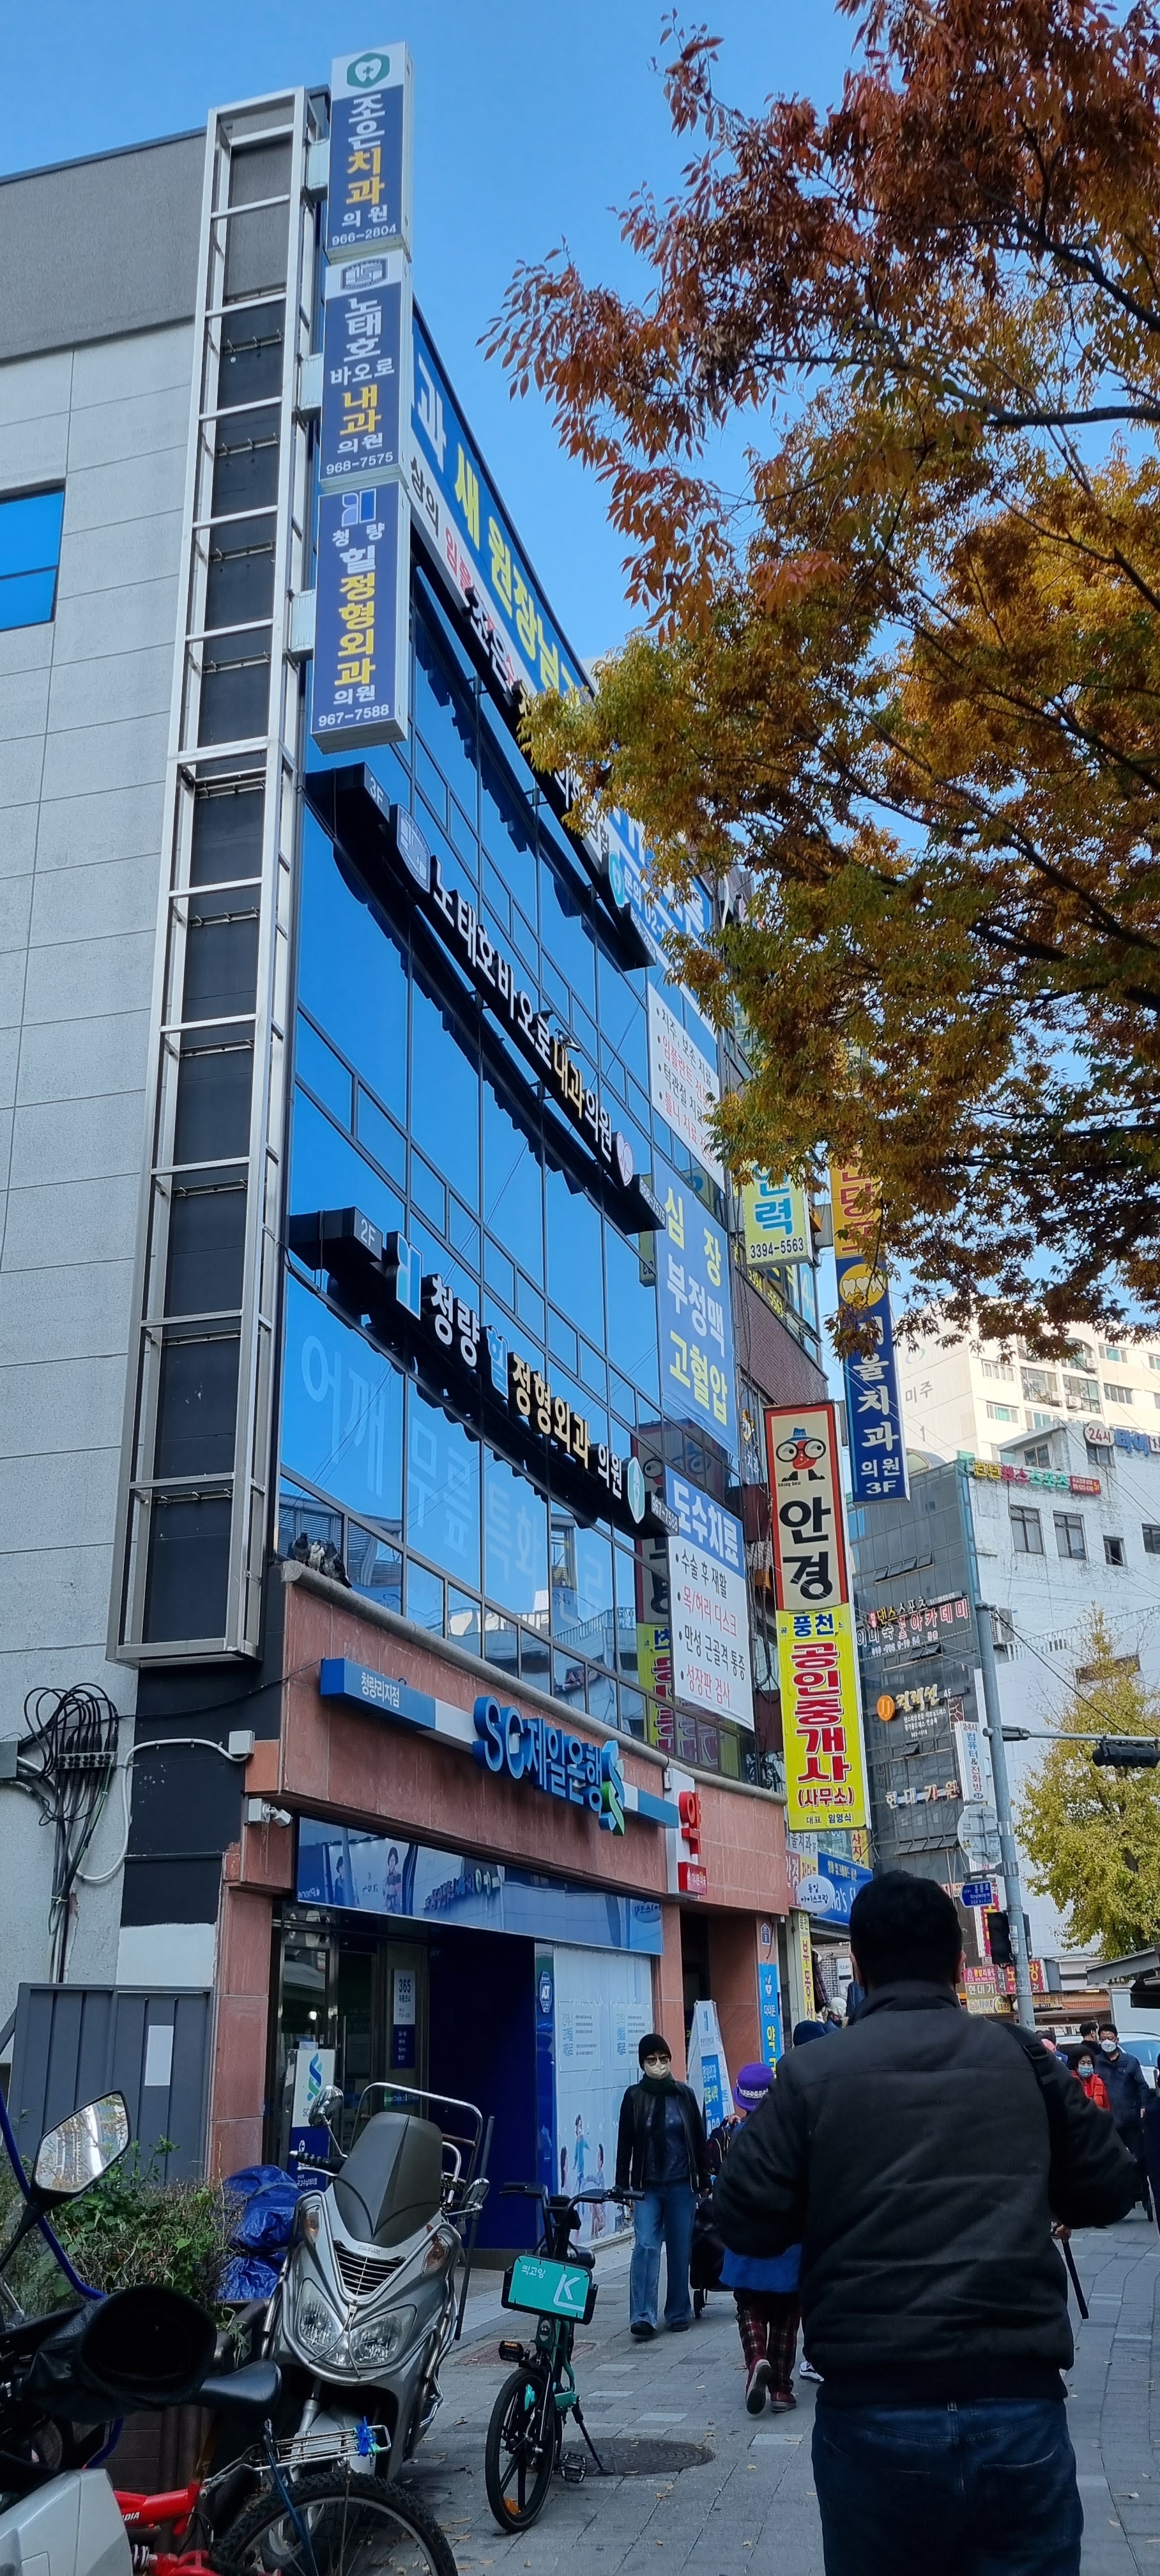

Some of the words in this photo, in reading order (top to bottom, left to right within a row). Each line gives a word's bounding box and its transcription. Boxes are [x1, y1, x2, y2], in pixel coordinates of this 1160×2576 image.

[342, 204, 388, 227] 의원
[344, 297, 382, 362] 노태호
[330, 358, 395, 385] 바오로
[340, 383, 382, 436] 내과
[337, 433, 383, 454] 의원
[326, 451, 393, 475] 968-7575
[454, 441, 480, 551] 새
[333, 685, 376, 705] 의원
[318, 704, 390, 727] 967-7588
[369, 776, 385, 809] 3F
[662, 1034, 693, 1089] 임플란트
[682, 1034, 697, 1070] 보존
[698, 1057, 712, 1090] 치료
[664, 1062, 687, 1108] 턱관절
[664, 1089, 681, 1126] 틀니
[683, 1114, 698, 1146] 치료
[360, 1217, 377, 1246] 2F
[750, 1237, 804, 1259] 3394-5563
[431, 1273, 481, 1368] 청량
[666, 1252, 725, 1359] 부정맥
[669, 1329, 728, 1427] 고혈압
[904, 1380, 934, 1404] 미주
[861, 1457, 901, 1479] 의원
[866, 1480, 897, 1495] 3F
[650, 1492, 679, 1531] 967-7588
[673, 1479, 740, 1569] 도수치료
[779, 1496, 834, 1601] 안경
[680, 1548, 699, 1583] 수술
[701, 1560, 709, 1583] 후
[711, 1566, 728, 1600] 재활
[683, 1585, 712, 1625] 목/허리
[714, 1604, 737, 1637] 디스크
[793, 1613, 834, 1637] 풍천
[910, 1598, 969, 1632] 아카데미
[684, 1625, 701, 1657] 만성
[705, 1634, 729, 1672] 근골격
[731, 1650, 746, 1681] 통증
[361, 1671, 400, 1709] 청량리지점
[686, 1664, 713, 1700] 성장판
[714, 1676, 731, 1708] 검사
[791, 1641, 852, 1784] 공인중개사
[472, 1694, 603, 1814] SC제일은행
[798, 1785, 855, 1809] (사무소)
[806, 1815, 822, 1825] 대표
[800, 1894, 828, 1904] 아이스크림
[807, 1883, 820, 1893] 동일
[398, 1978, 411, 1993] 365
